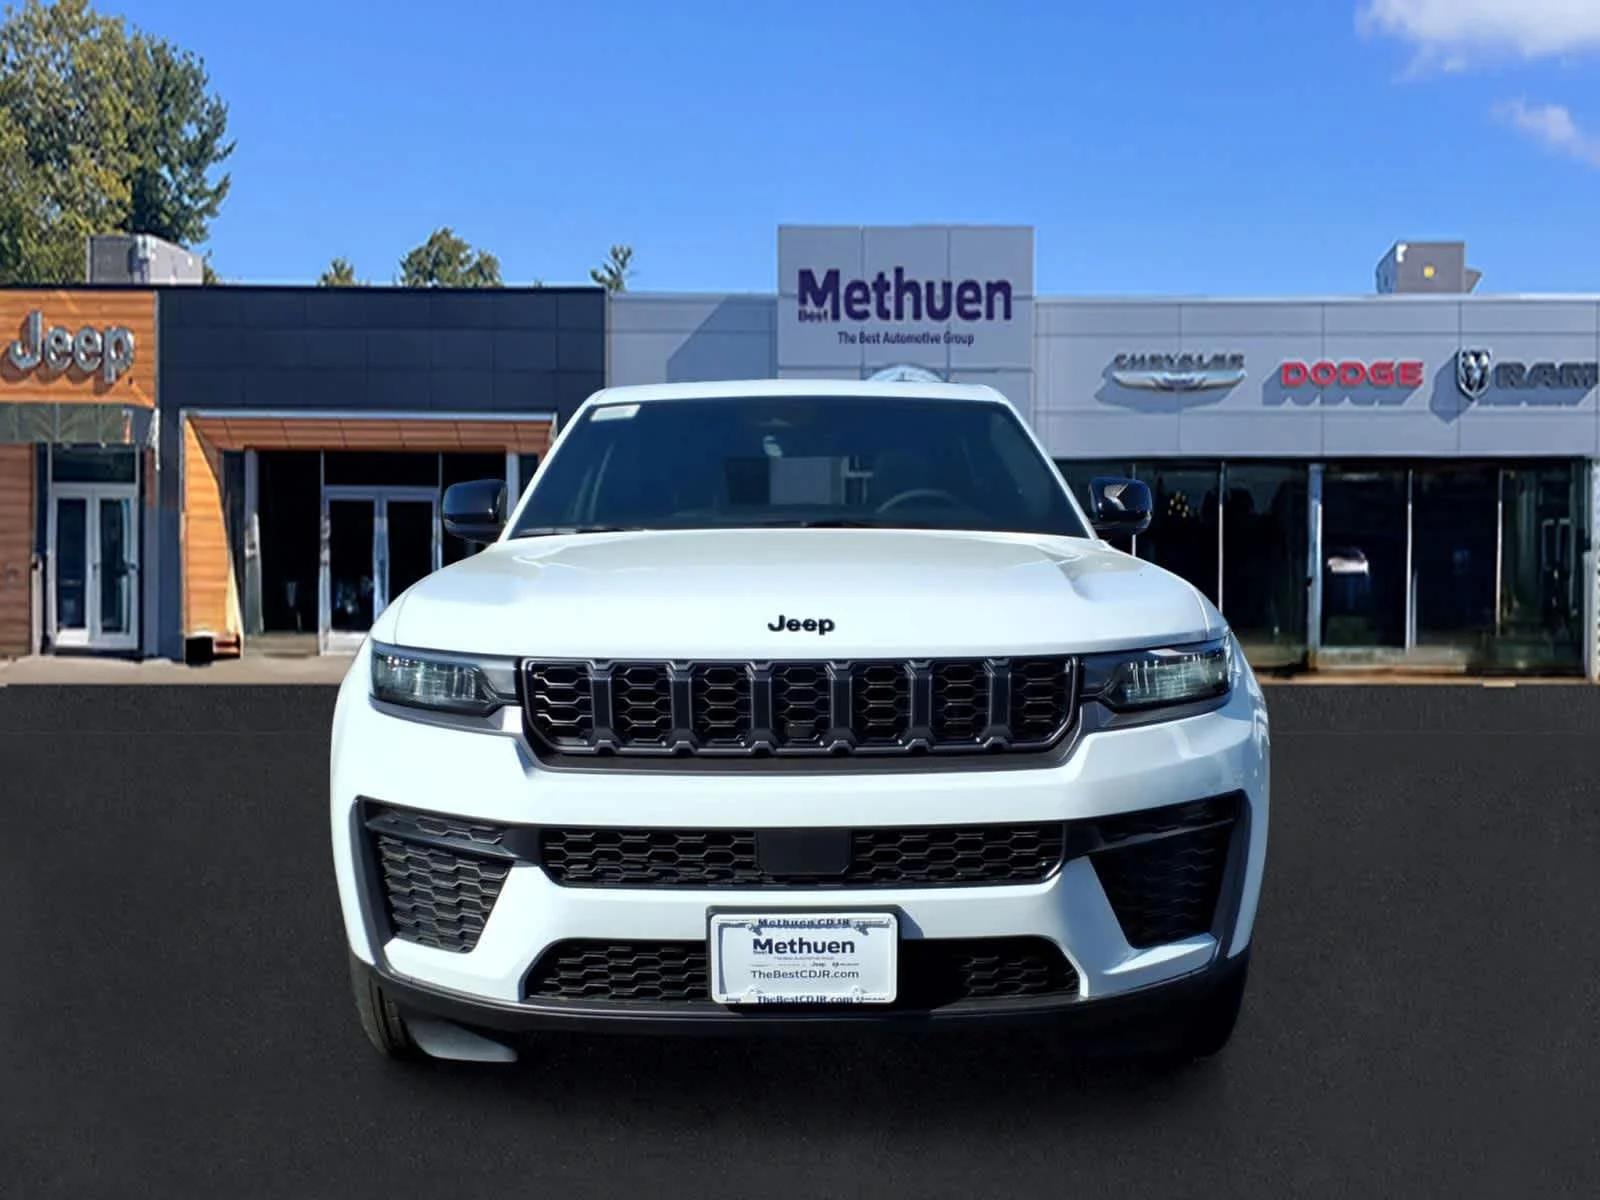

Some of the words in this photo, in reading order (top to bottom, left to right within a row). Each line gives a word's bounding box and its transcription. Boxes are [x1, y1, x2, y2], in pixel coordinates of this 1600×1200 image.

[798, 266, 1012, 321] Methuen
[9, 310, 135, 384] Jeep
[838, 331, 857, 344] The
[859, 331, 881, 344] Best
[883, 331, 941, 344] Automotive
[943, 331, 974, 347] Group
[1114, 354, 1244, 370] CHRYSLER
[1282, 361, 1424, 386] DODGE
[1495, 362, 1599, 388] RAM
[767, 614, 835, 636] Jeep
[753, 938, 855, 954] Methuen
[751, 970, 859, 979] TheBestCDJR.com
